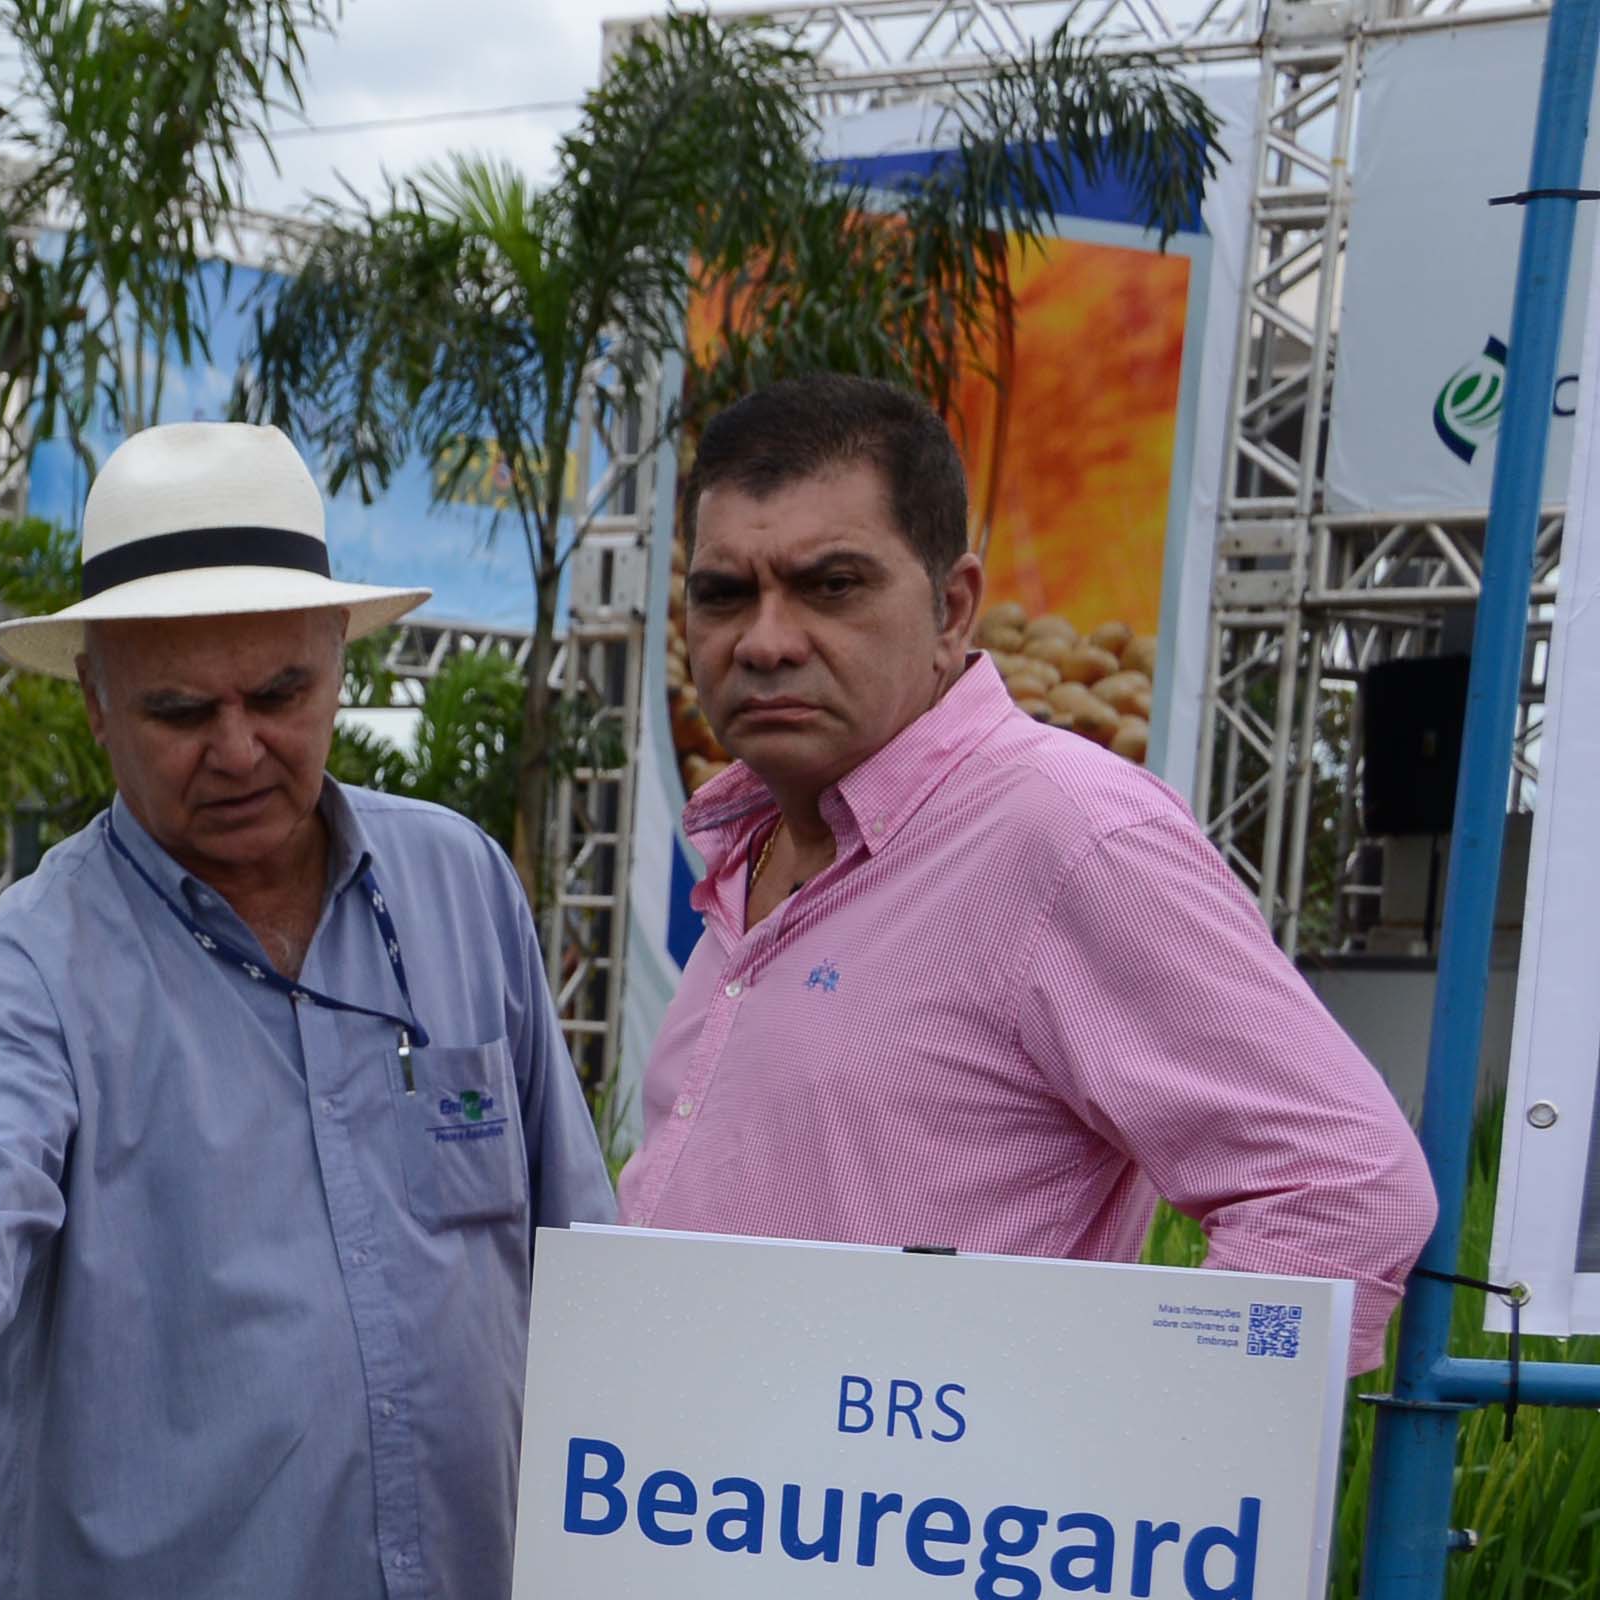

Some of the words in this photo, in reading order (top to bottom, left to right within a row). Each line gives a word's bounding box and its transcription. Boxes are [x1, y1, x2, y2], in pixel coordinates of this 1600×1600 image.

[1158, 1304, 1181, 1314] Mais
[1152, 1318, 1179, 1328] sobre
[1181, 1320, 1225, 1332] cultivares
[1228, 1323, 1240, 1333] da
[1197, 1334, 1239, 1347] Embrapa
[837, 1375, 968, 1444] BRS
